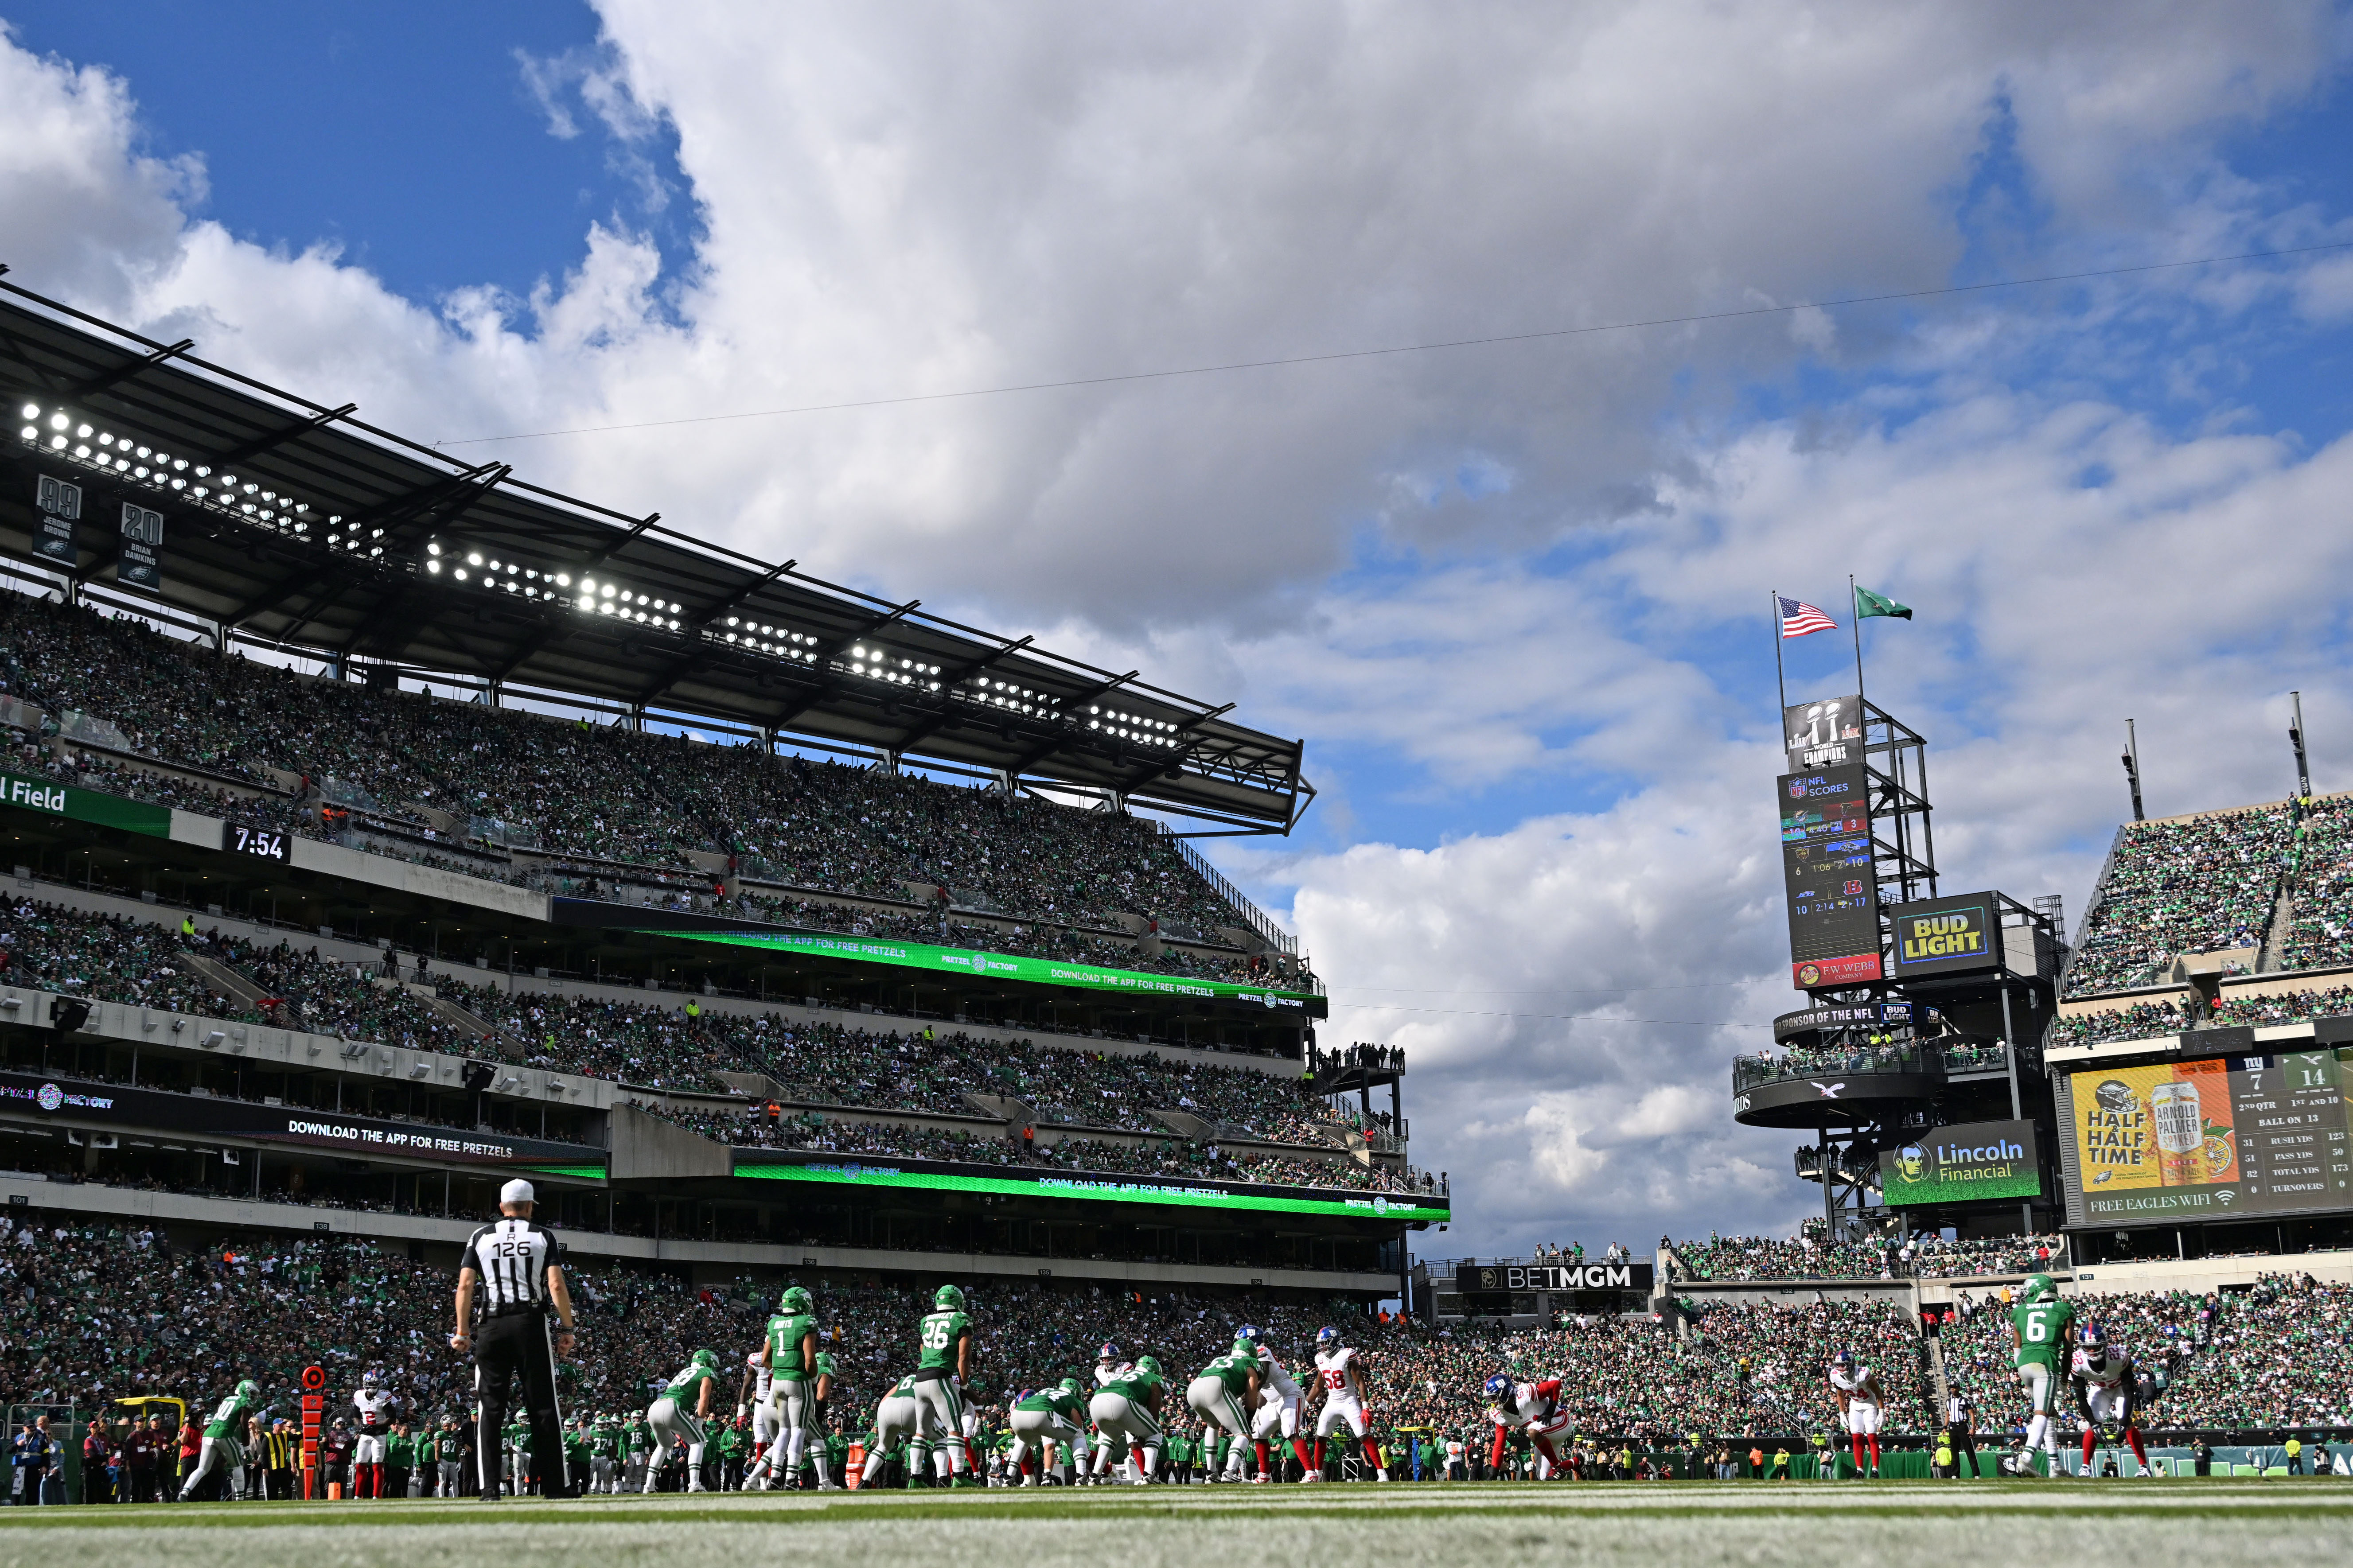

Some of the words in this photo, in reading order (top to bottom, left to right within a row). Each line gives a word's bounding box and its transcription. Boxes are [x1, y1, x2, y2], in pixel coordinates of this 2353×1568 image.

[41, 478, 78, 520] 99
[44, 515, 71, 531] JEROME
[124, 506, 160, 546] 20
[43, 525, 70, 539] BROWN
[131, 543, 151, 555] BRIAN
[125, 550, 156, 566] DAWKINS
[1814, 742, 1834, 751] WORLD
[1804, 746, 1847, 764] CHAMPIONS
[1808, 776, 1827, 786] NFL
[12, 780, 65, 812] Field
[1791, 786, 1806, 797] NFL
[1809, 783, 1849, 797] SCORES
[1851, 819, 1857, 828] 3
[235, 827, 283, 860] 7:54
[1796, 867, 1801, 876] 6
[1813, 863, 1831, 873] 1:06
[1851, 858, 1863, 868] 10
[1796, 906, 1808, 915] 10
[1816, 902, 1834, 912] 2:14
[1841, 900, 1847, 909] 2
[1855, 897, 1866, 907] 17
[1913, 914, 1968, 938] BUD
[774, 933, 791, 944] THE
[795, 935, 813, 945] APP
[815, 938, 834, 949] FOR
[837, 941, 859, 952] FREE
[862, 943, 906, 957] PRETZELS
[1905, 931, 1980, 957] LIGHT
[942, 955, 970, 965] PRETZEL
[988, 961, 1018, 971] FACTORY
[1844, 961, 1875, 972] WEBB
[1051, 969, 1099, 982] DOWNLOAD
[1102, 975, 1118, 984] THE
[1138, 980, 1153, 989] FOR
[1156, 982, 1174, 992] FREE
[1176, 984, 1214, 997] PRETZELS
[1835, 972, 1863, 980] COMPANY
[1238, 993, 1263, 1002] PRETZEL
[1278, 998, 1304, 1008] FACTORY
[1782, 1014, 1815, 1029] SPONSOR
[1817, 1012, 1828, 1023] OF
[1831, 1009, 1851, 1021] THE
[1854, 1008, 1874, 1019] NFL
[2250, 1074, 2261, 1090] 7
[2301, 1069, 2325, 1086] 14
[2157, 1105, 2196, 1120] ARNOLD
[2256, 1101, 2276, 1111] QTR
[2088, 1111, 2144, 1128] HALF
[2158, 1119, 2197, 1134] PALMER
[2258, 1117, 2285, 1126] BALL
[289, 1120, 358, 1140] DOWNLOAD
[362, 1129, 383, 1143] THE
[386, 1132, 407, 1145] APP
[410, 1136, 432, 1148] FOR
[436, 1139, 460, 1152] FREE
[463, 1142, 512, 1158] PRETZELS
[2088, 1130, 2144, 1147] HALF
[2163, 1132, 2194, 1148] SPIKED
[2271, 1136, 2294, 1145] RUSH
[2328, 1132, 2344, 1140] 123
[1938, 1139, 2023, 1164] Lincoln
[2088, 1148, 2142, 1164] TIME
[862, 1166, 900, 1176] FACTORY
[1940, 1163, 2012, 1182] Financial
[1039, 1177, 1096, 1191] DOWNLOAD
[1099, 1181, 1117, 1192] THE
[1119, 1183, 1138, 1194] APP
[1140, 1184, 1158, 1195] FOR
[1161, 1186, 1182, 1197] FREE
[1185, 1187, 1228, 1200] PRETZELS
[2271, 1183, 2324, 1192] TURNOVERS
[1345, 1199, 1372, 1209] PRETZEL
[1388, 1202, 1416, 1211] FACTORY
[2091, 1198, 2123, 1213] FREE
[2126, 1196, 2177, 1210] EAGLES
[2179, 1194, 2211, 1206] WIFI
[493, 1241, 530, 1257] 126
[1508, 1266, 1631, 1288] BETMGM
[774, 1319, 793, 1328] HURTS
[2026, 1311, 2046, 1342] 6
[922, 1320, 950, 1349] 26
[776, 1331, 785, 1357] 1
[636, 1381, 641, 1389] 11
[1324, 1370, 1346, 1390] 58
[1845, 1388, 1869, 1402] 24
[365, 1411, 376, 1425] 2
[630, 1432, 642, 1444] 16
[442, 1440, 456, 1453] 87
